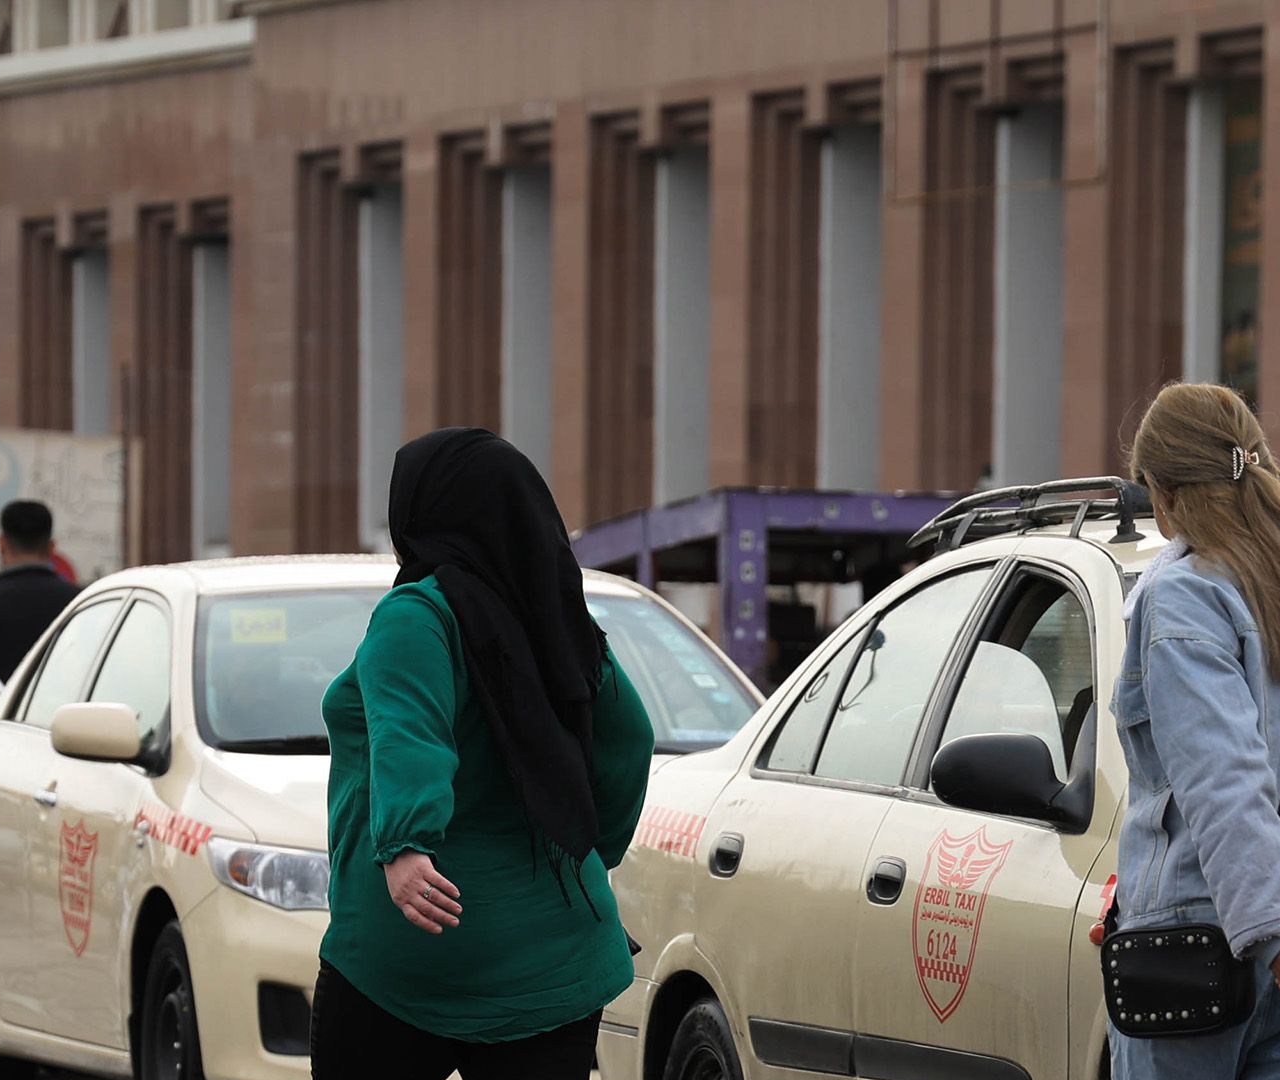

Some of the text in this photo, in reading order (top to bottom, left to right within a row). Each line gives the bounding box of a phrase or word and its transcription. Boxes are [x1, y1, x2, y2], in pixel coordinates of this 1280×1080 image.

[923, 887, 978, 911] ERBIL TAXI
[926, 928, 957, 962] 6124
